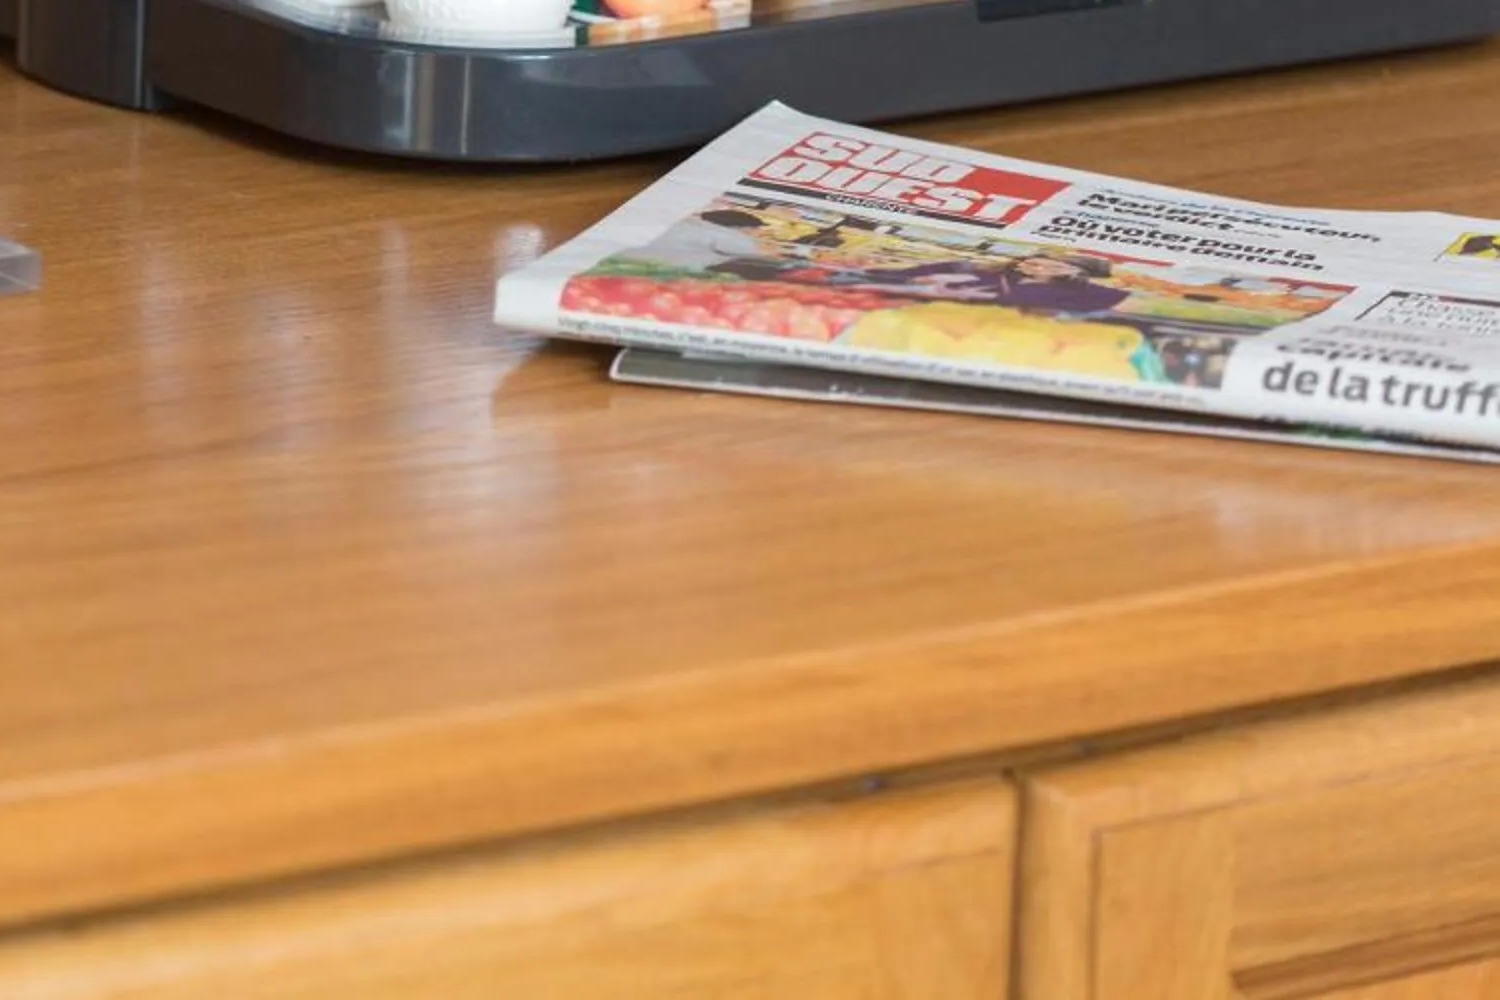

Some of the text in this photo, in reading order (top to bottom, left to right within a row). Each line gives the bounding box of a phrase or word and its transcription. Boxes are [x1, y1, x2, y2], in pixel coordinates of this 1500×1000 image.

[792, 132, 977, 184] SUD
[756, 155, 1038, 222] OUEST
[1103, 223, 1198, 244] voter
[1196, 237, 1283, 257] pour
[1283, 248, 1317, 262] la
[1261, 360, 1500, 418] de la truff
